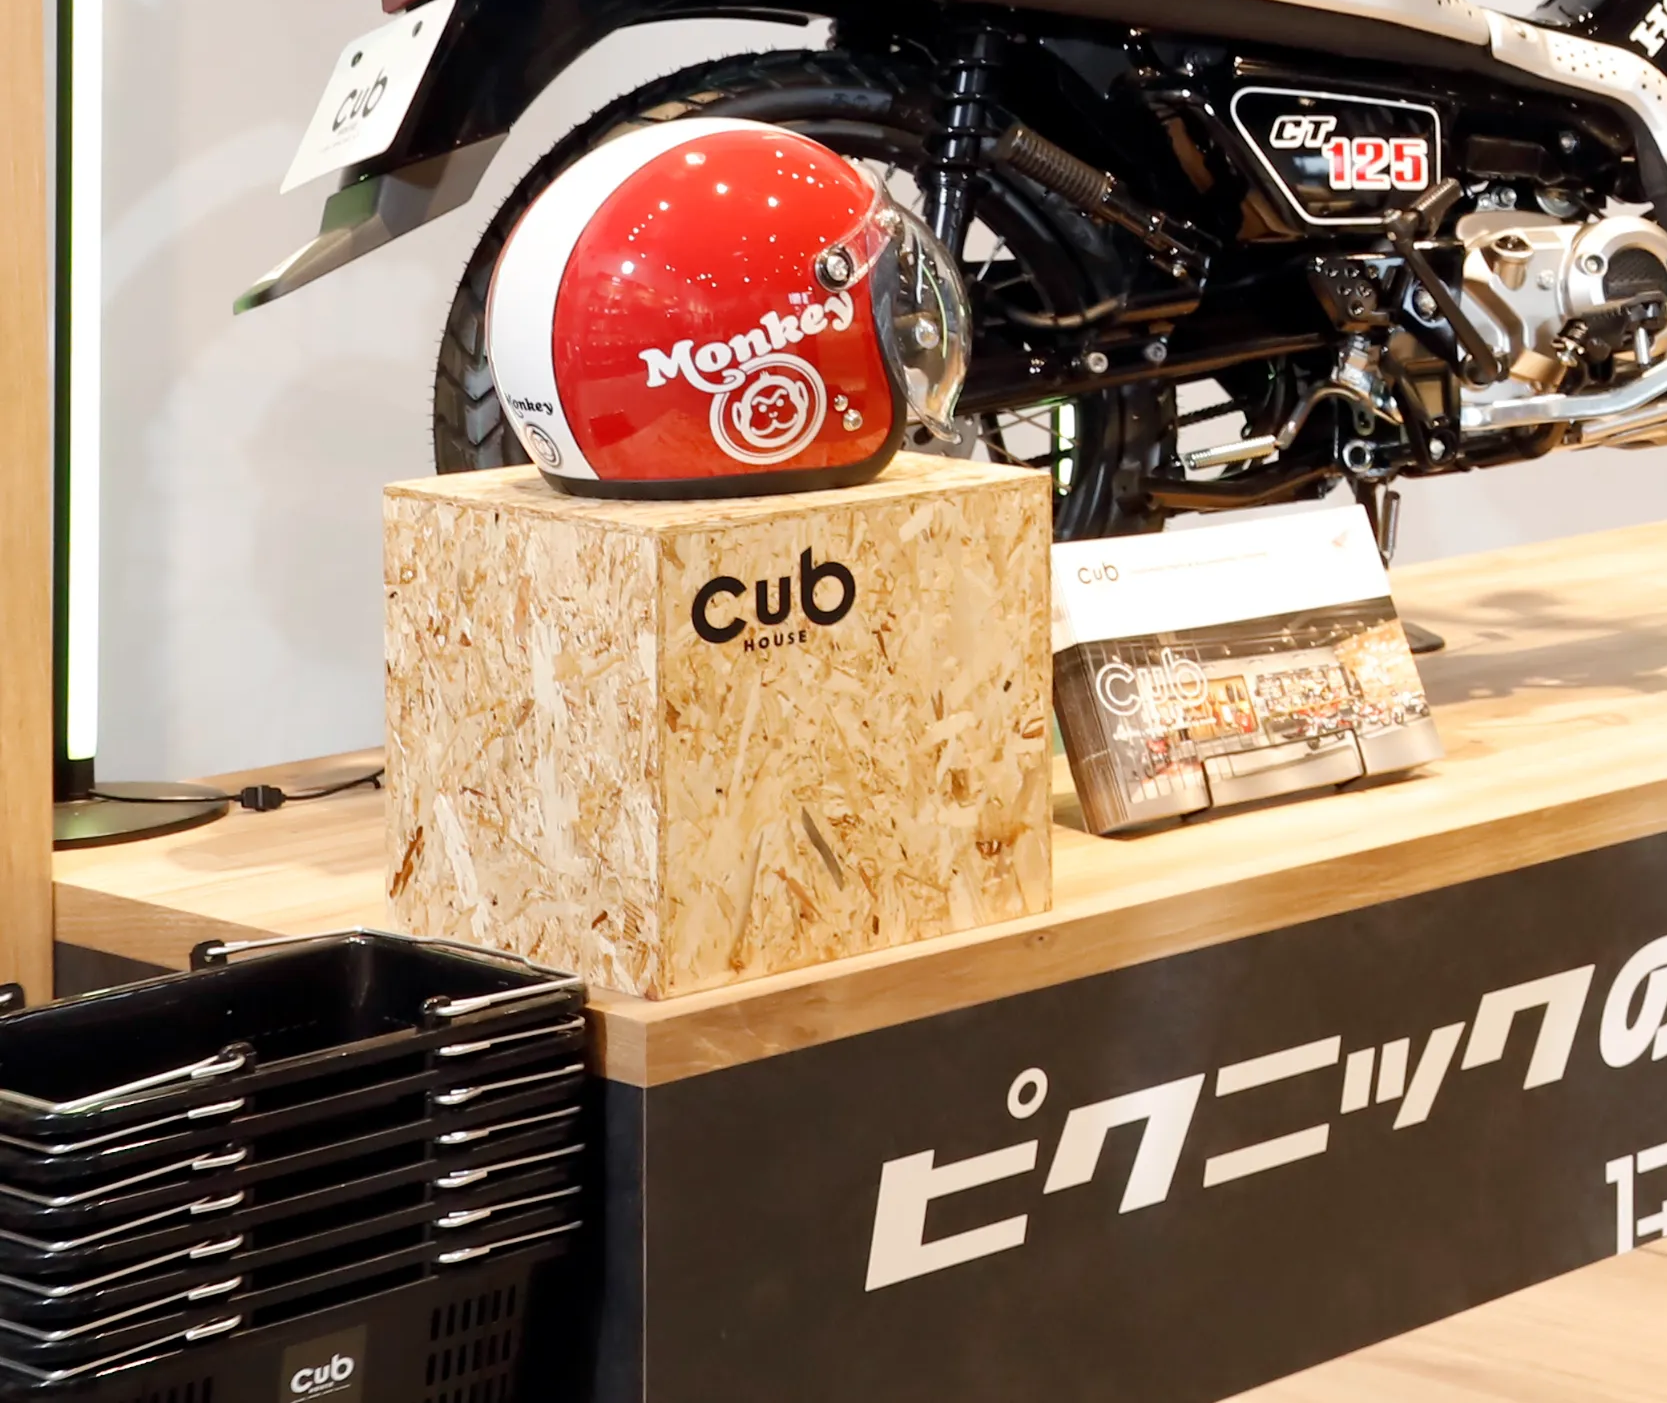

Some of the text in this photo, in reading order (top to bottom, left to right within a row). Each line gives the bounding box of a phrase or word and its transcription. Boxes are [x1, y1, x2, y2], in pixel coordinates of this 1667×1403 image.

[1269, 115, 1337, 148] CT
[1322, 137, 1428, 190] 125
[638, 290, 854, 394] Monkey
[743, 630, 808, 652] HOUSE
